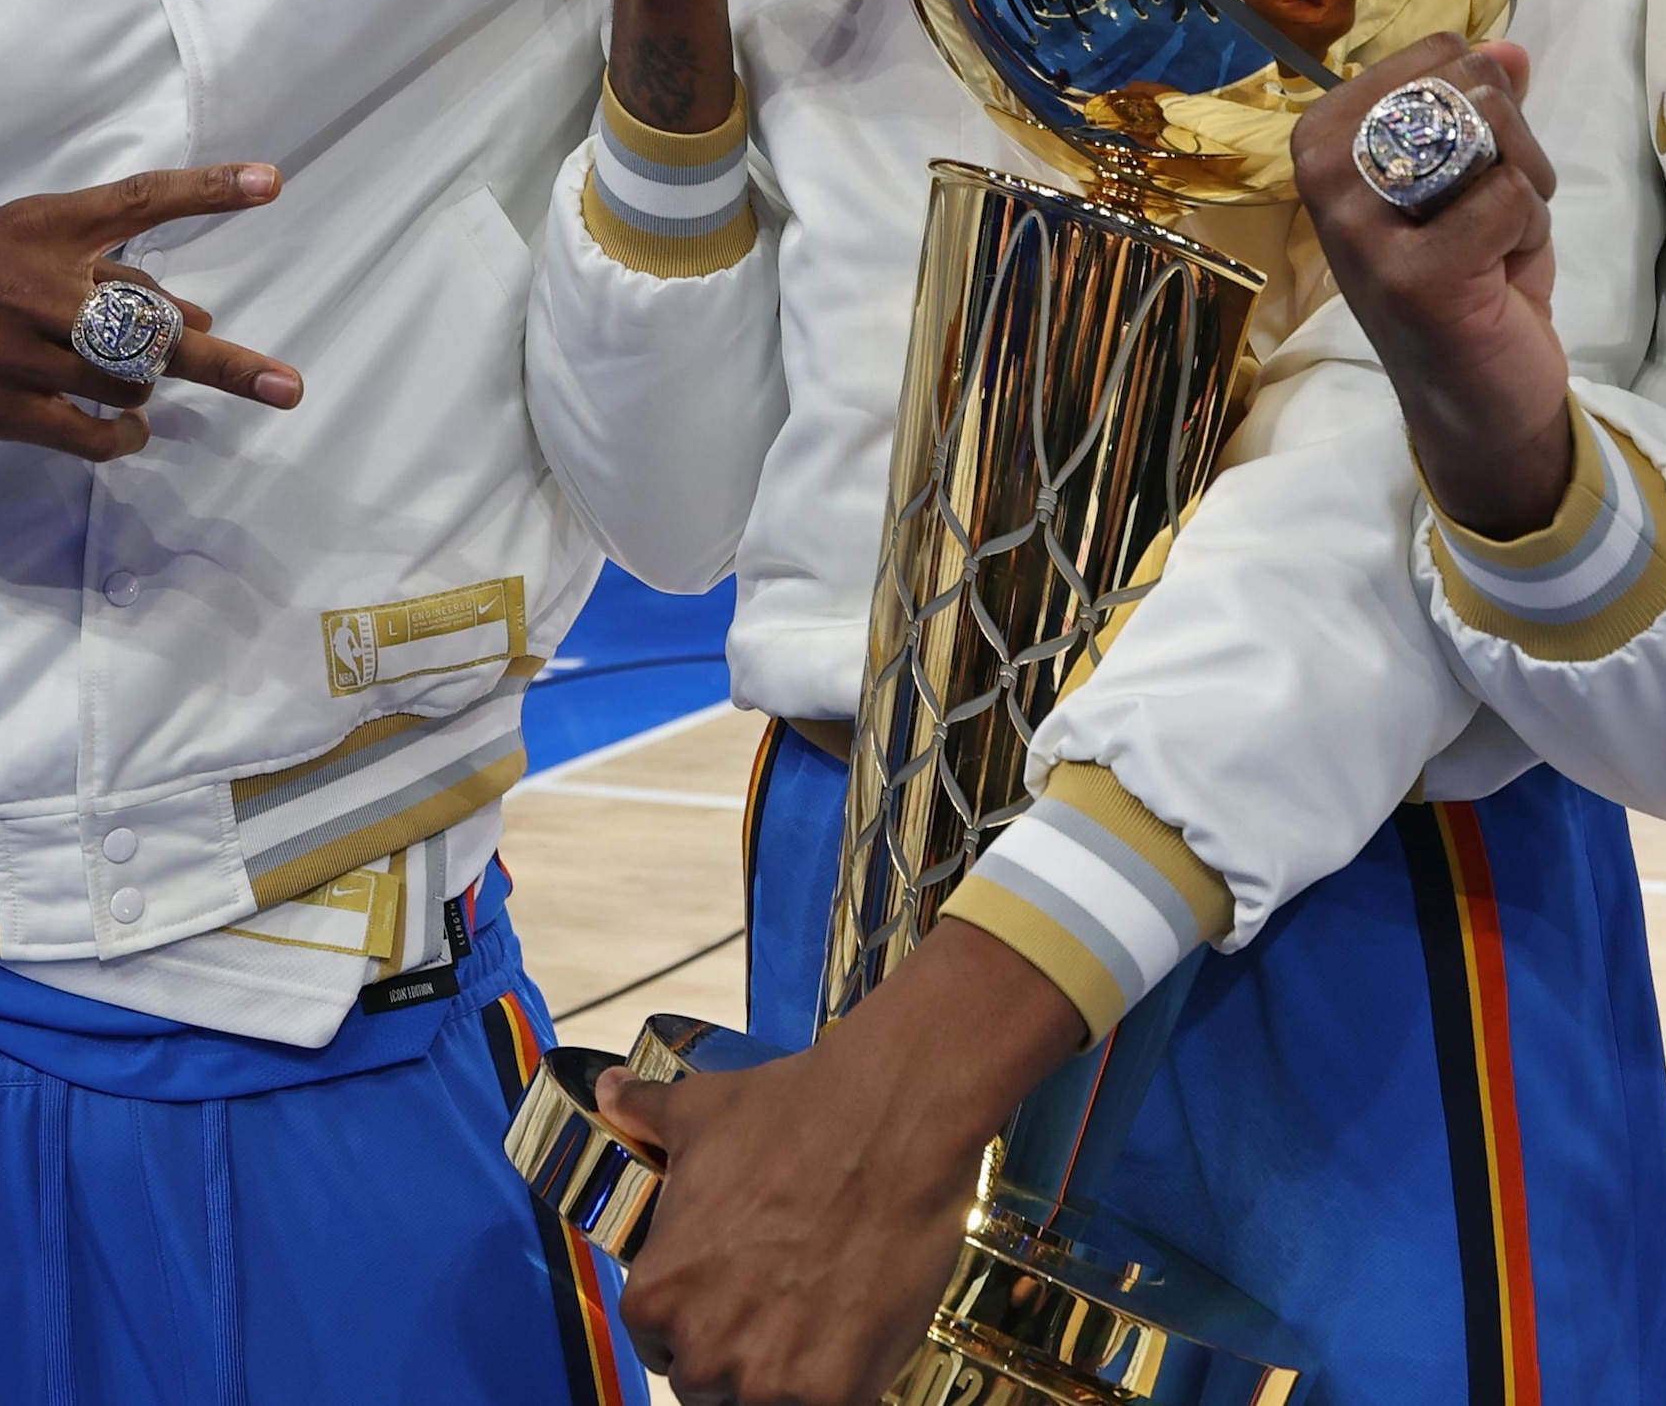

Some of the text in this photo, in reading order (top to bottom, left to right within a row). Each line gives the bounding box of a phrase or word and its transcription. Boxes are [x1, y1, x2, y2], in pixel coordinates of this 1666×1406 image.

[412, 600, 473, 623] ENGINEERED
[388, 620, 399, 637] L
[389, 981, 435, 1004] ICON EDITION
